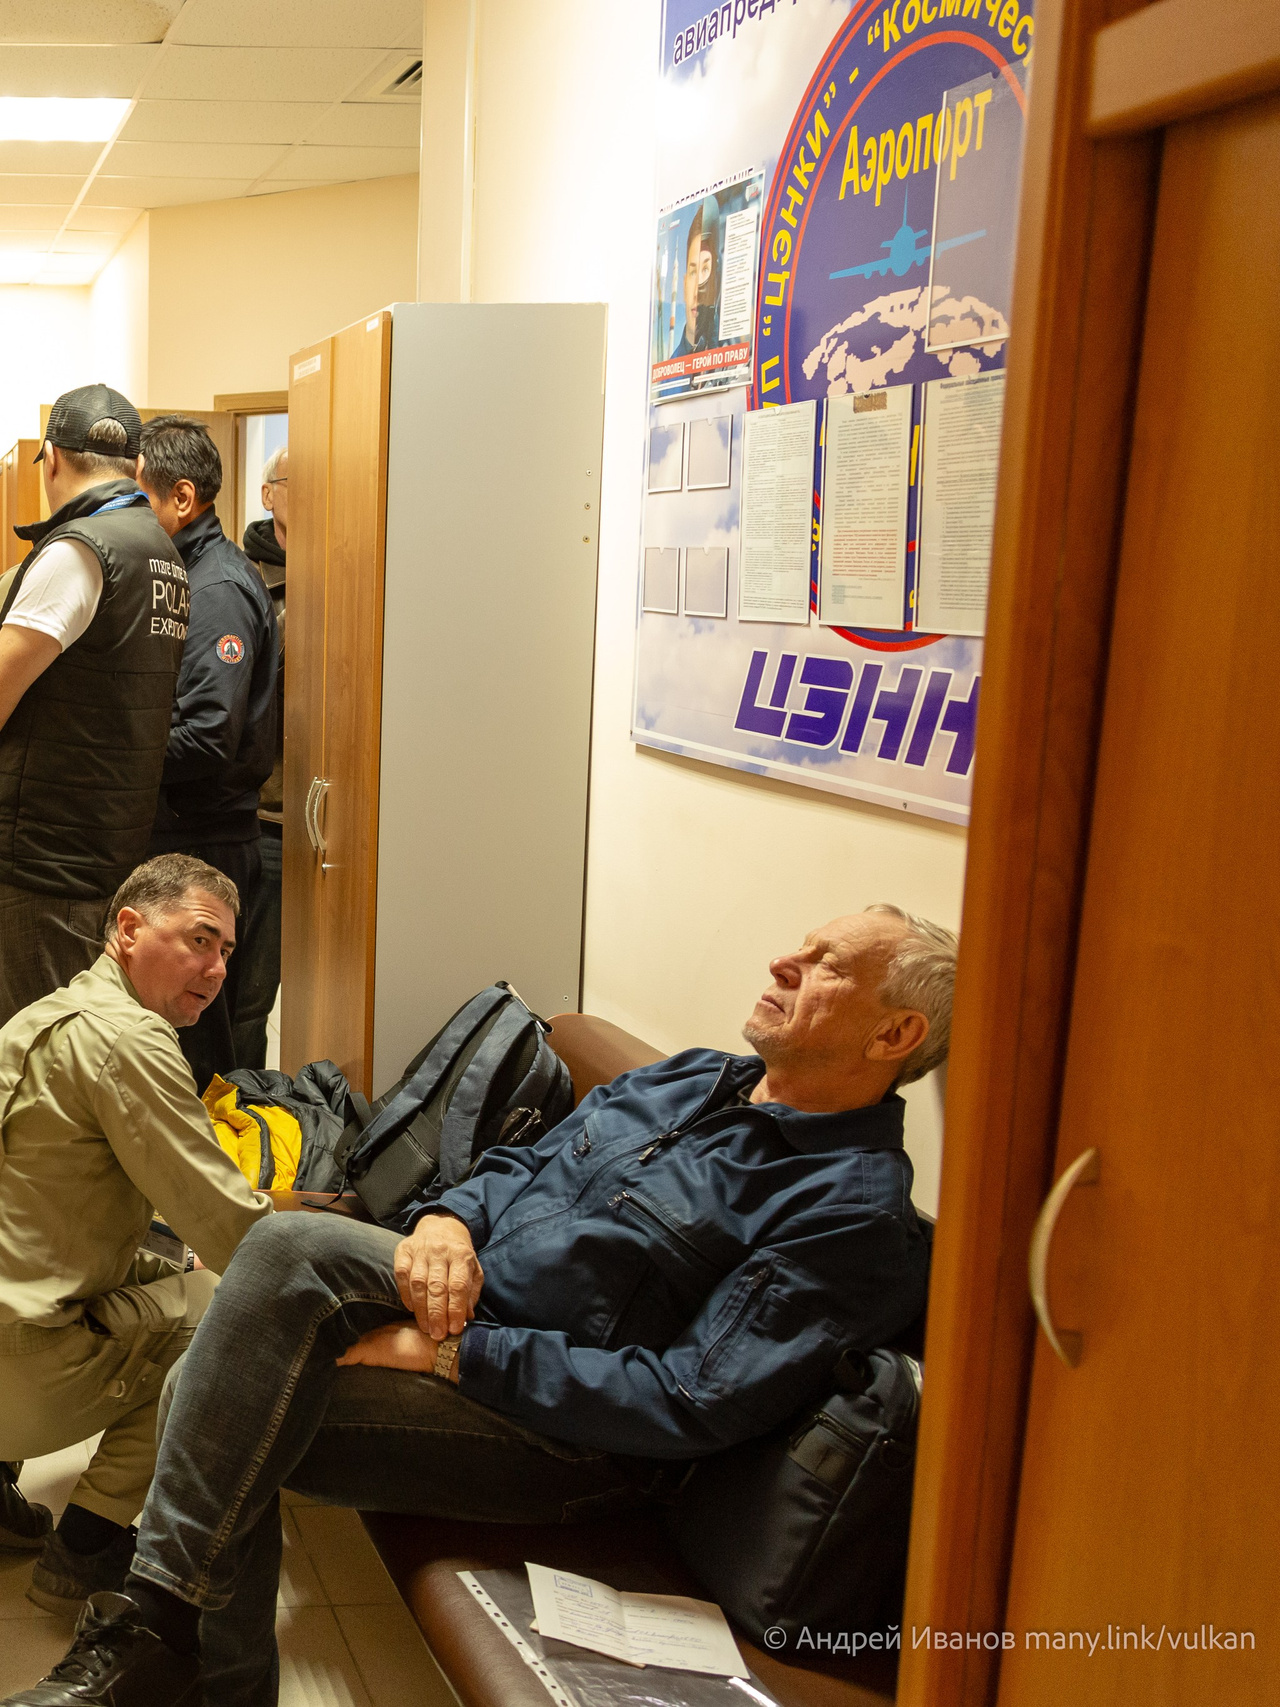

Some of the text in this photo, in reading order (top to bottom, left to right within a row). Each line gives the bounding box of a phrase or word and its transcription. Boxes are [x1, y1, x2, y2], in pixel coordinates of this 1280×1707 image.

[838, 88, 993, 207] Аэропорт
[652, 361, 685, 381] ДОБРОВОЛЕЦ
[692, 353, 712, 370] ГЕРОЙ
[713, 352, 723, 365] ПО
[724, 347, 748, 363] ПРАВУ
